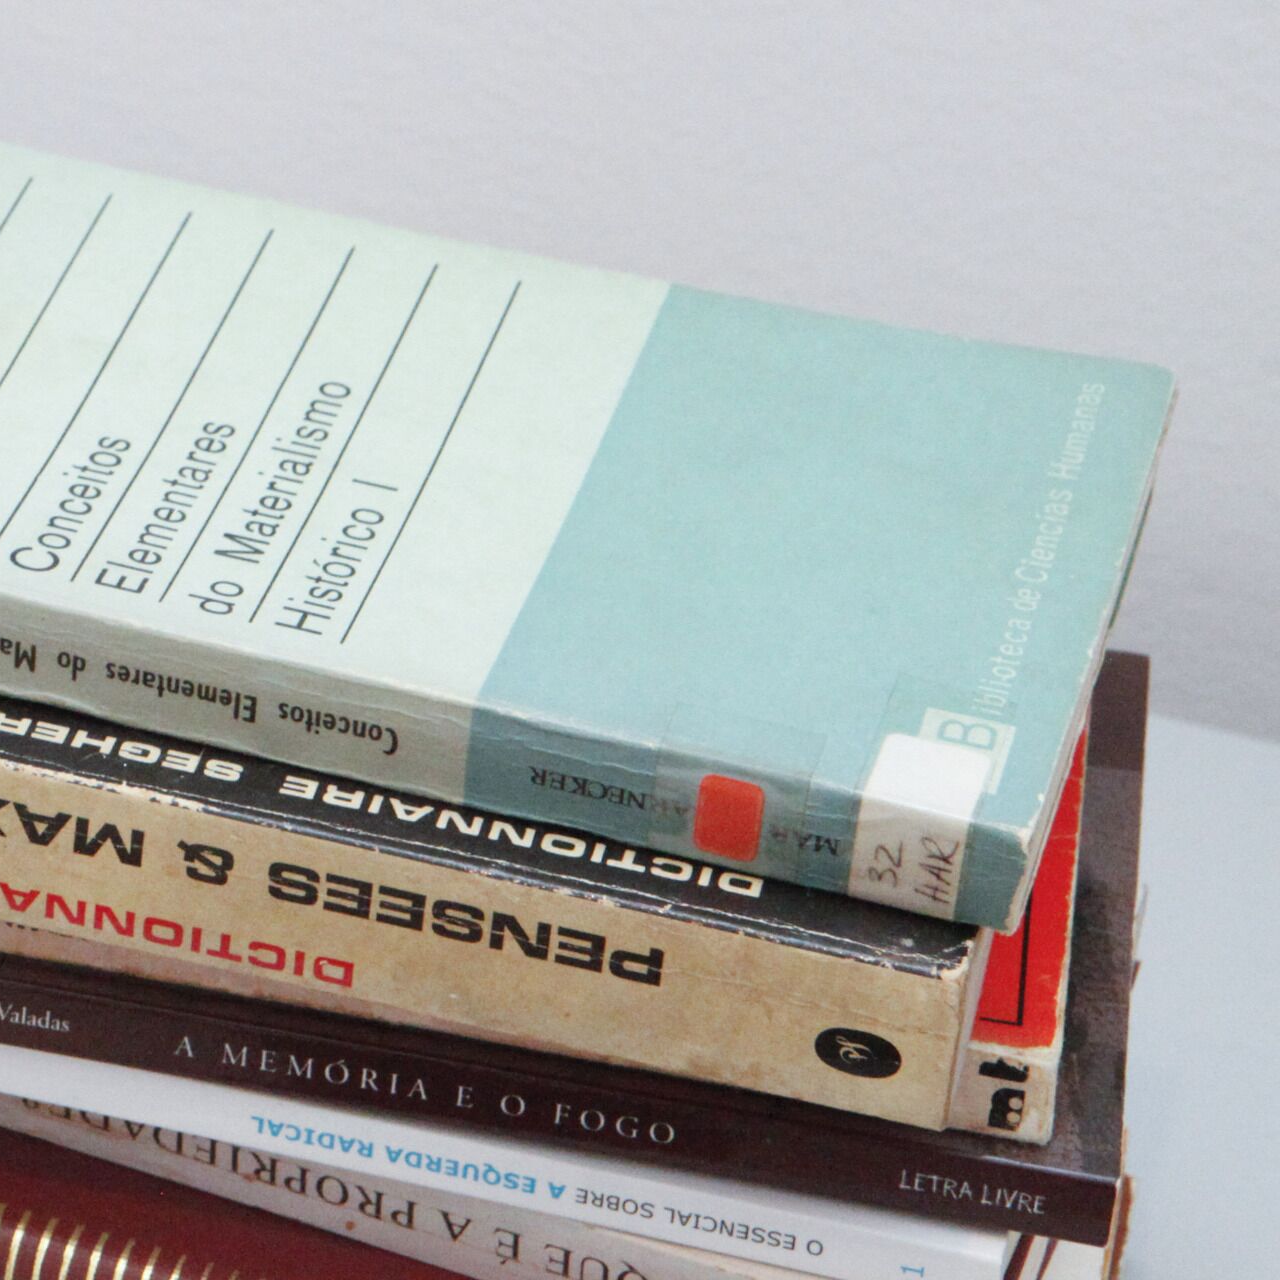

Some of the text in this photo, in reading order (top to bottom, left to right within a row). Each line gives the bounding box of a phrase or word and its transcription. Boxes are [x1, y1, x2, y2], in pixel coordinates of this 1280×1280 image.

[10, 435, 131, 573] Conceitos
[94, 421, 236, 594] Elementares
[189, 380, 351, 615] do Materialismo
[1009, 587, 1042, 612] de
[1049, 381, 1105, 481] Humanas
[275, 507, 384, 635] Histórico
[56, 651, 86, 681] do
[105, 661, 257, 722] Elementares
[278, 701, 399, 756] Conceitos
[177, 840, 234, 886] &
[279, 775, 764, 899] DICTIONNAIRE
[267, 861, 664, 987] PENSEES
[174, 1036, 676, 1145] A MEMÓRIA E O FOGO
[250, 1115, 823, 1256] O ESSENCIAL SOBRE A ESQUERDA RADICAL
[436, 1209, 472, 1243] A
[899, 1170, 1045, 1215] LETRA LIVRE
[494, 1227, 521, 1265] É
